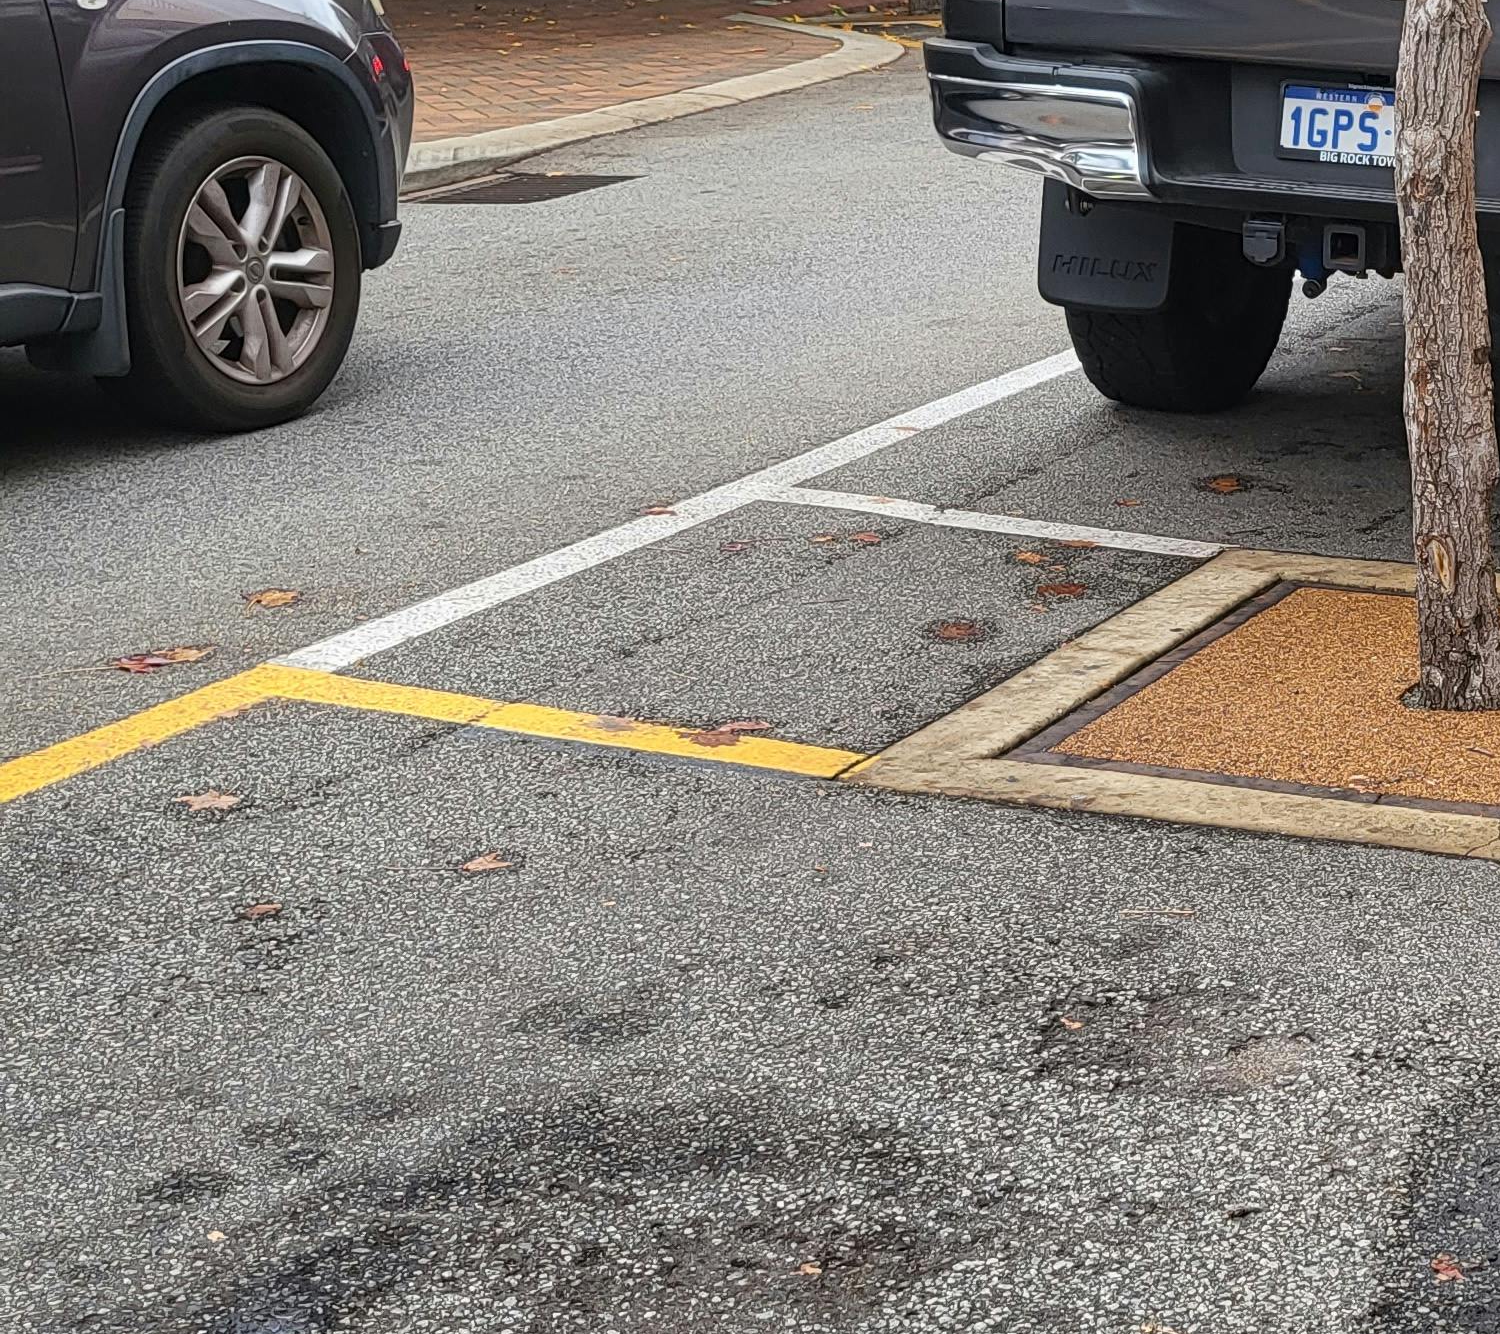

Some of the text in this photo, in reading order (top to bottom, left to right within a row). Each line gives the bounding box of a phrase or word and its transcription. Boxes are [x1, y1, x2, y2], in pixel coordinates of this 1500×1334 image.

[1315, 91, 1358, 103] WESTERN
[1320, 151, 1338, 163] BIG
[1340, 153, 1370, 166] ROCK
[1052, 254, 1158, 283] HILUX
